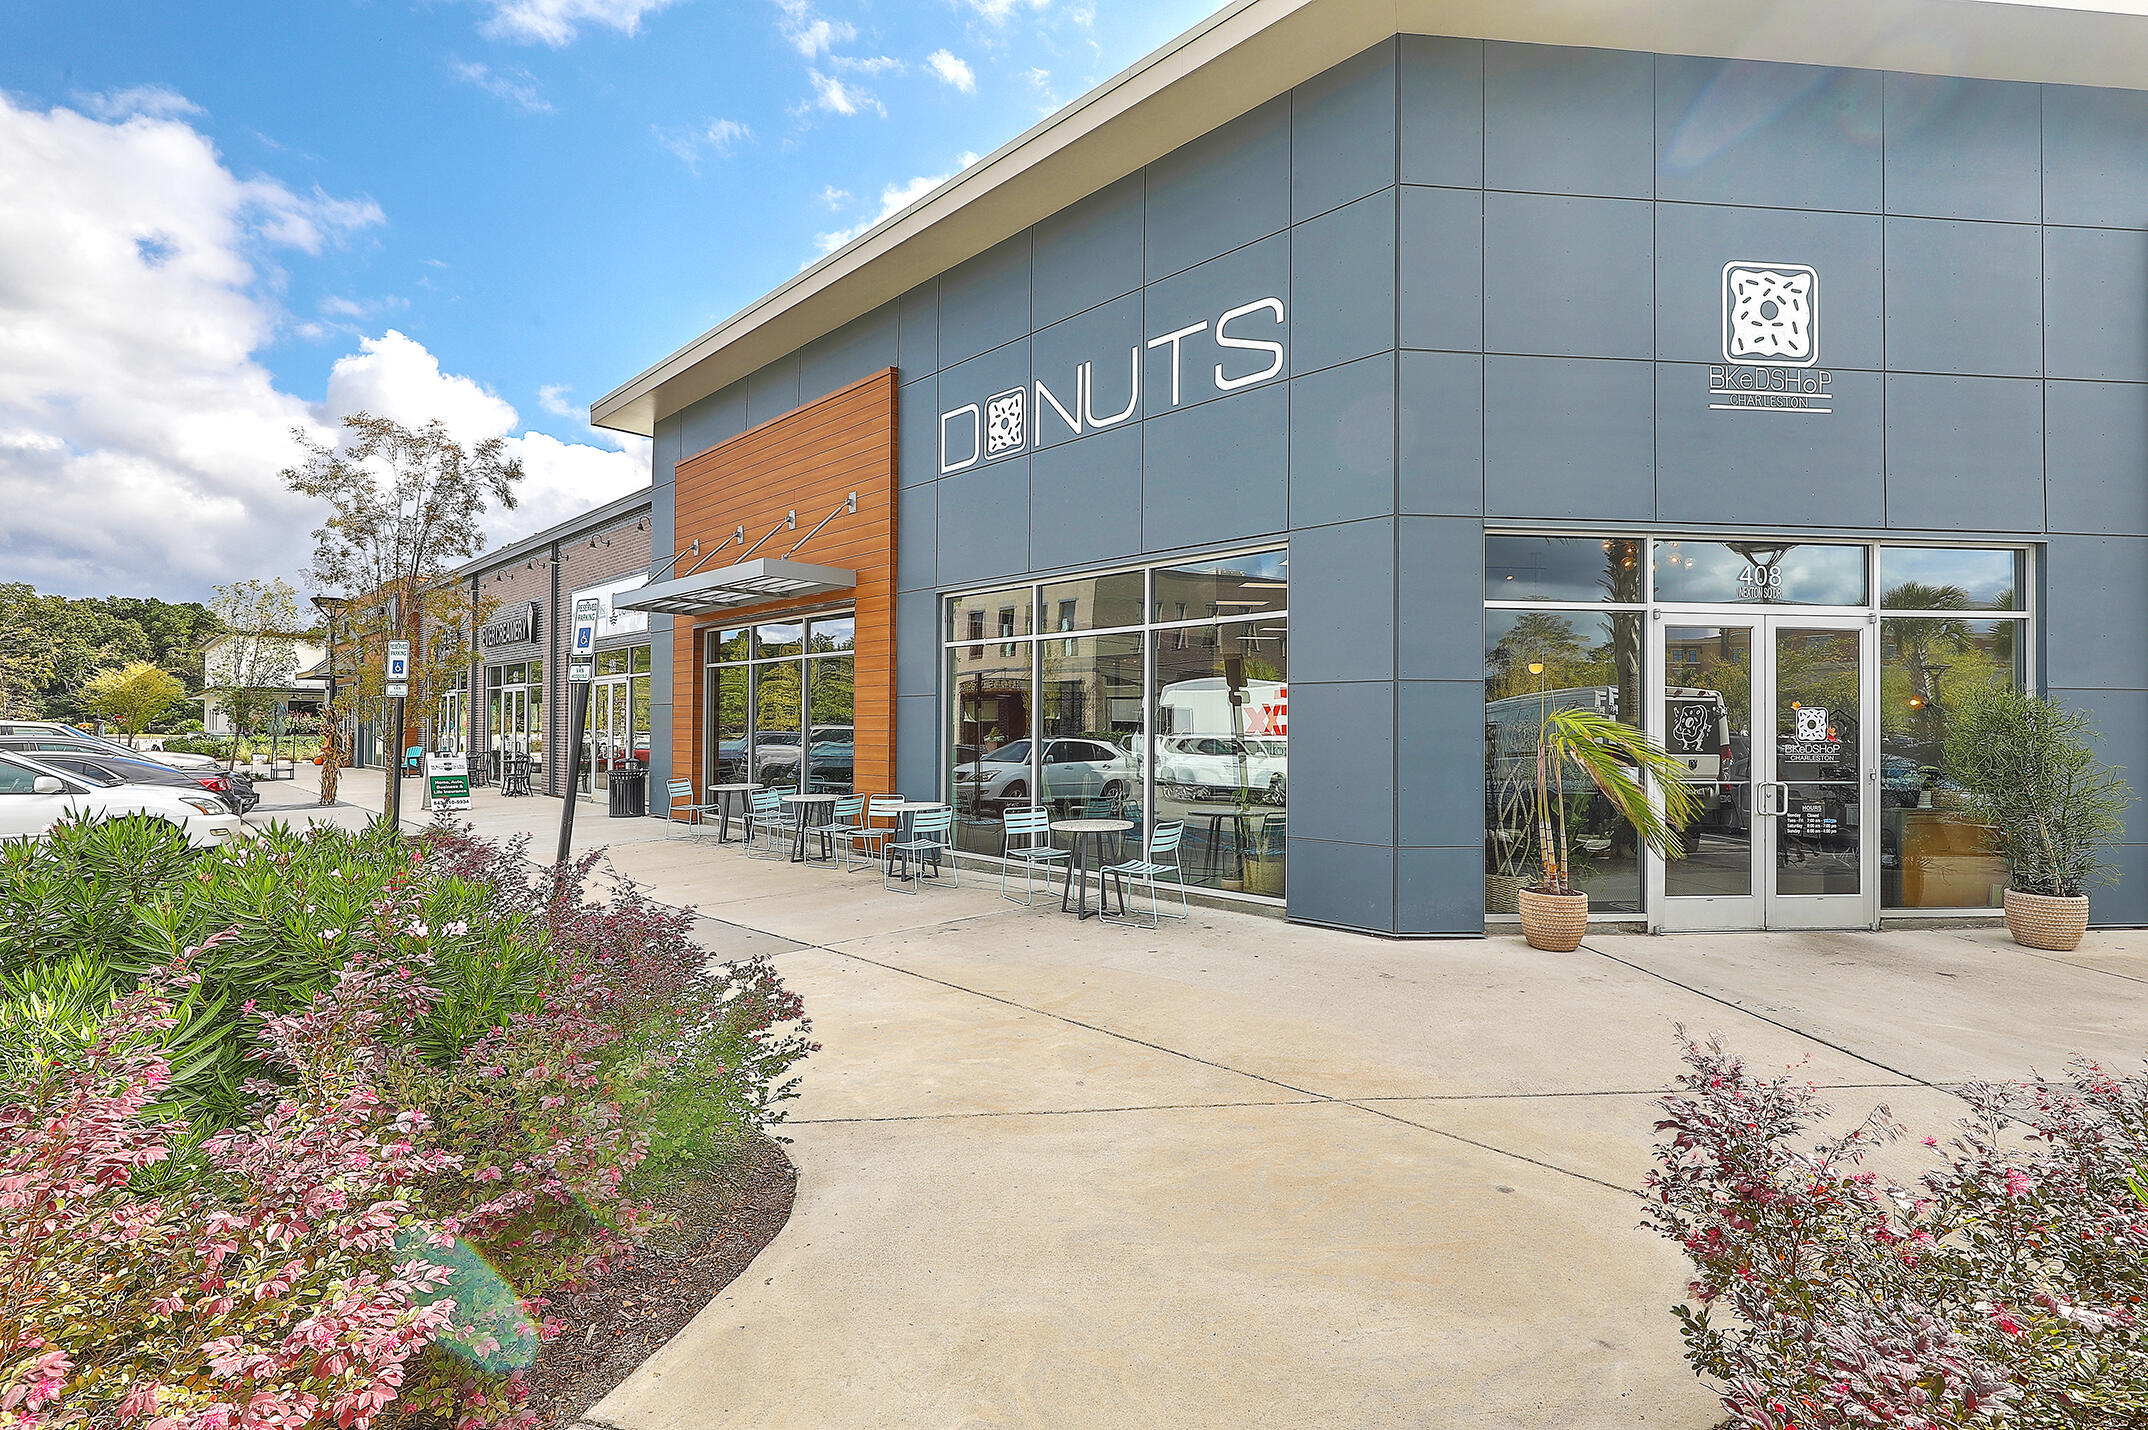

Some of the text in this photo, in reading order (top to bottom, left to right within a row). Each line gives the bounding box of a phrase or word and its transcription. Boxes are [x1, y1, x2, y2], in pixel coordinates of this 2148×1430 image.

[1729, 393, 1809, 408] CHARLESTON
[1739, 565, 1782, 587] 408
[1738, 587, 1782, 599] NEXTON SQ DR
[577, 613, 596, 622] PARKING
